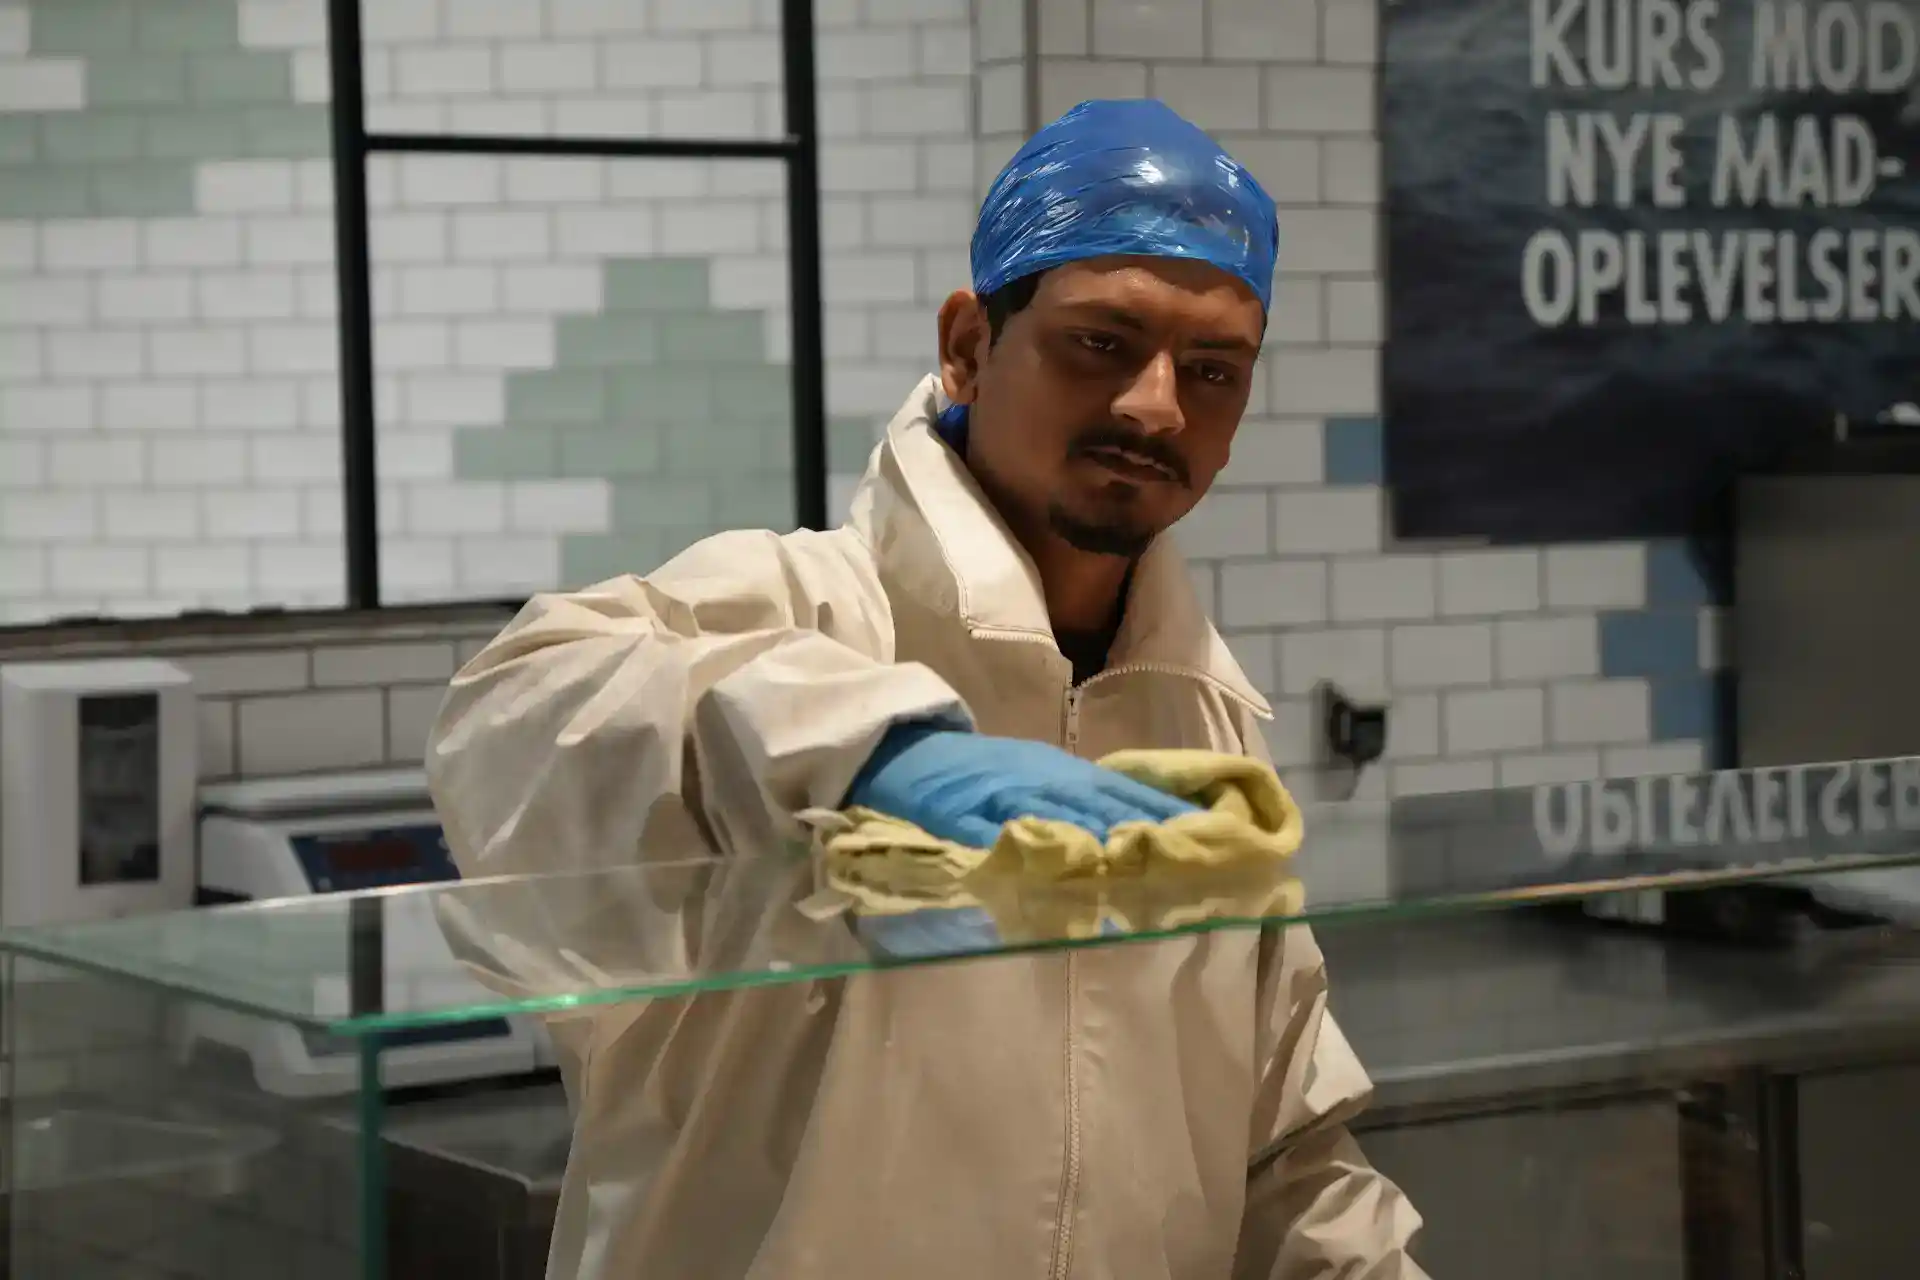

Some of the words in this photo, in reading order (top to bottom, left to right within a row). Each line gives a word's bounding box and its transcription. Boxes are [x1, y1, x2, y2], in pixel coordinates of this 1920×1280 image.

[1529, 0, 1724, 90] KURS
[1750, 0, 1917, 94] MOD
[1546, 111, 1686, 208] NYE
[1711, 113, 1906, 207] MAD-
[1521, 227, 1920, 327] OPLEVELSER
